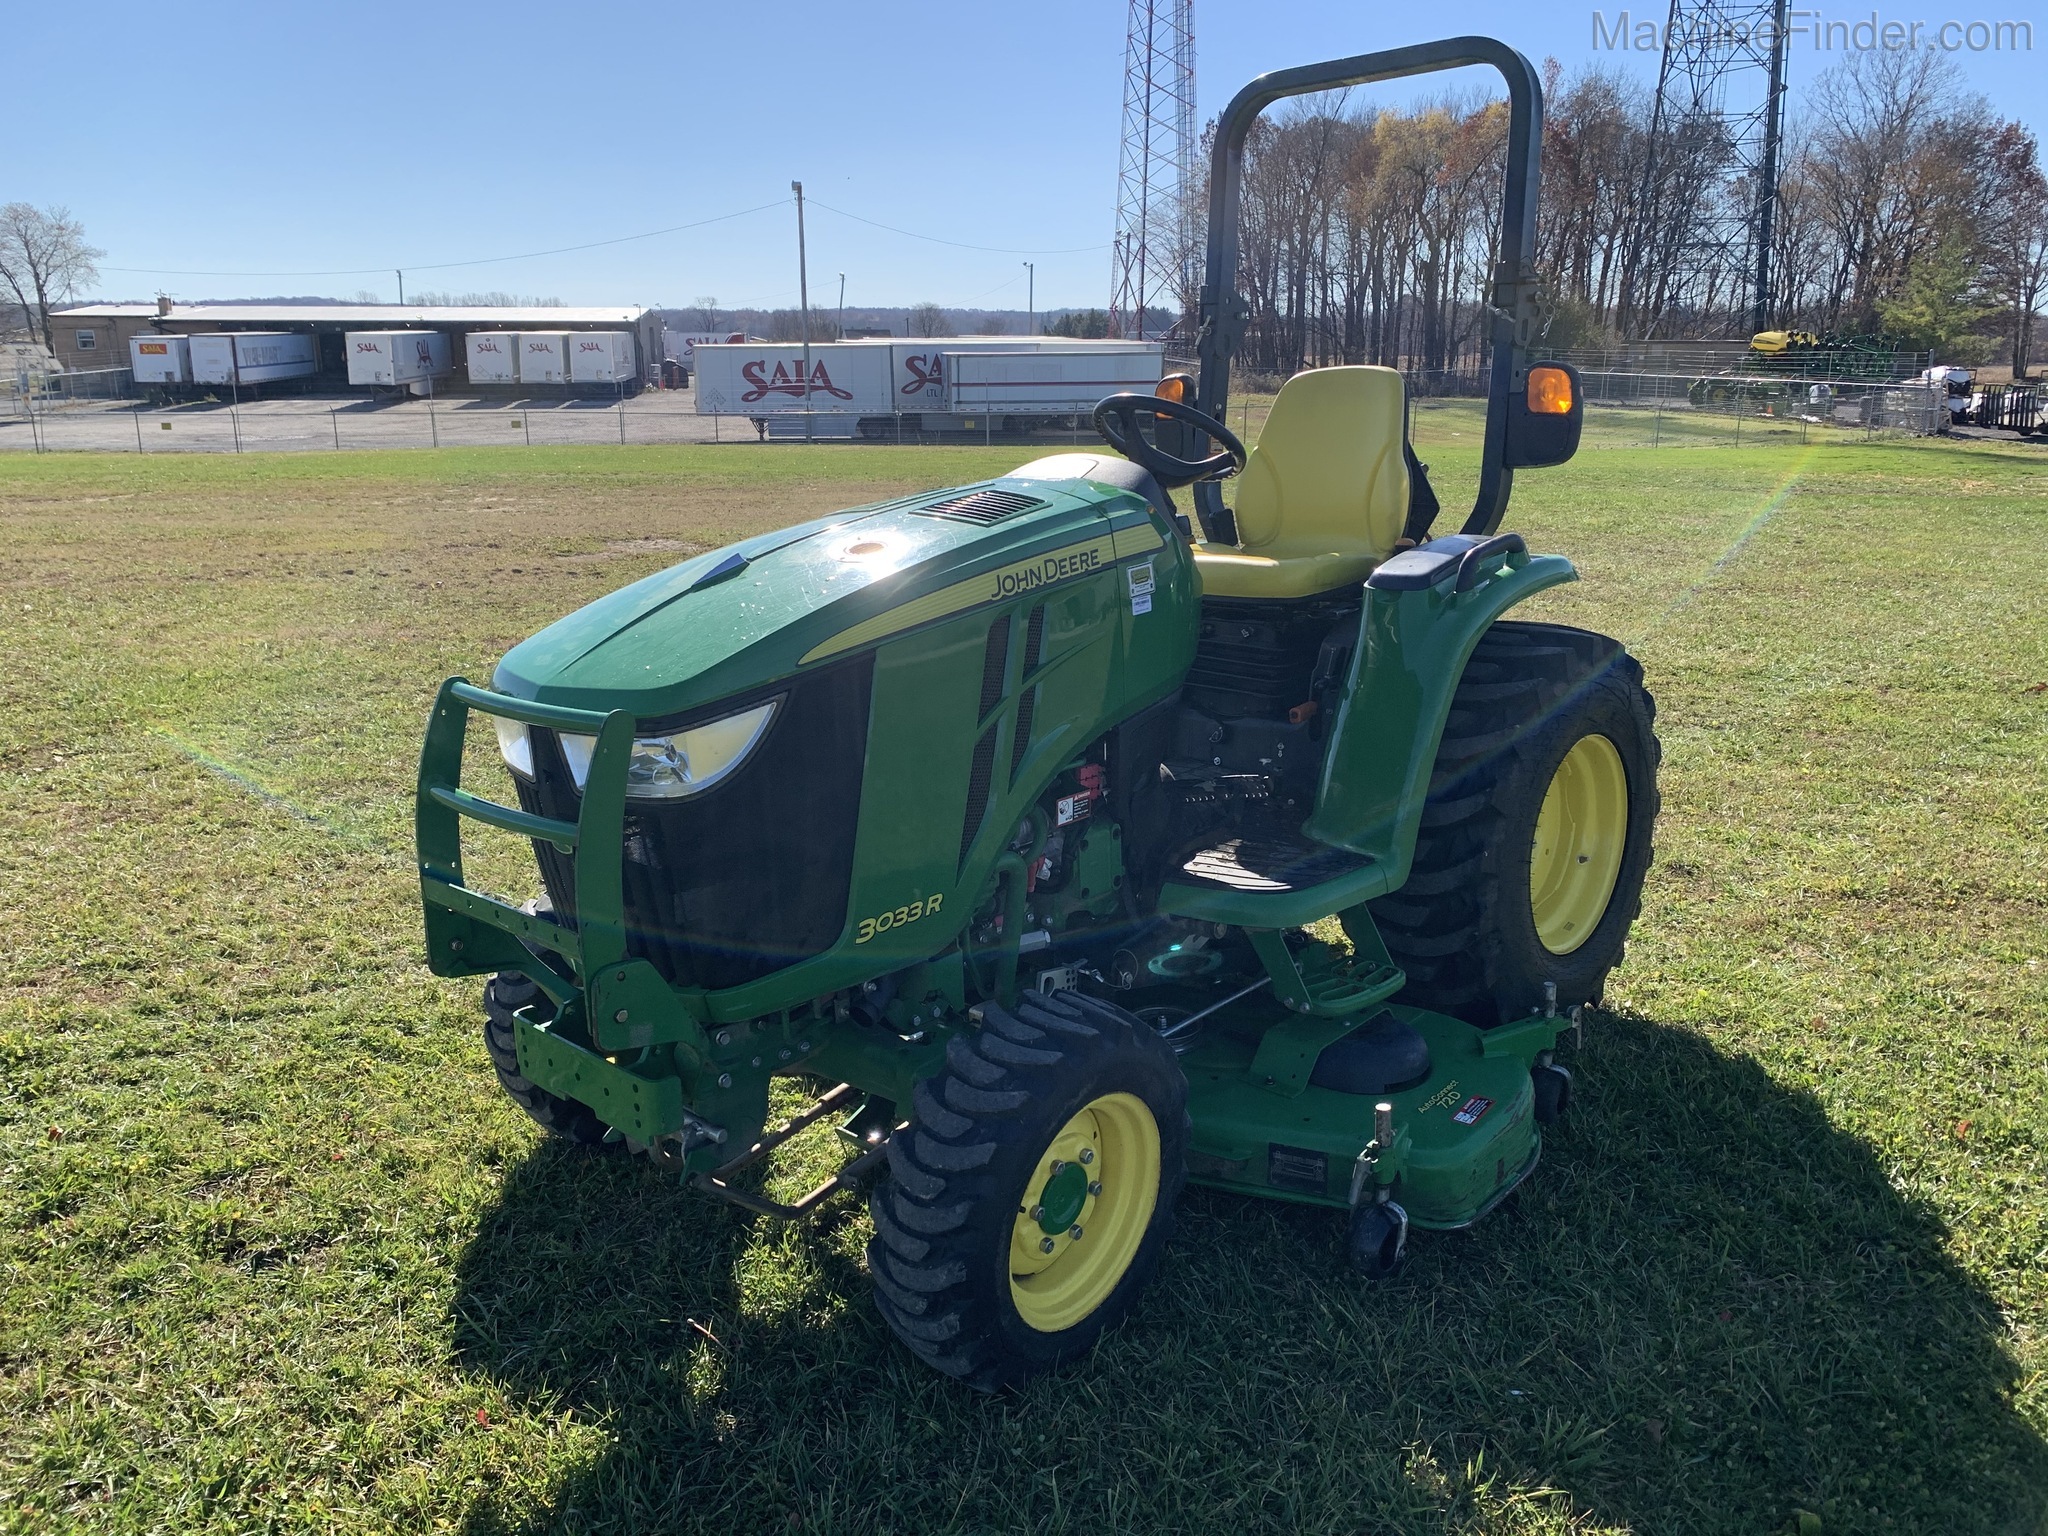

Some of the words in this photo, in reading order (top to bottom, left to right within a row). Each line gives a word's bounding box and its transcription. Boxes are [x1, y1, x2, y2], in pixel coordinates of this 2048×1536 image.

[142, 344, 165, 354] SAIA
[356, 342, 382, 354] SAIA
[477, 343, 502, 354] SAIA
[528, 343, 553, 354] SAIA
[579, 342, 604, 353] SAIA
[741, 359, 853, 403] SAIA
[900, 353, 943, 395] SA
[991, 565, 1042, 598] JOHN
[1044, 548, 1101, 578] DEERE
[1418, 1080, 1460, 1114] AutoConnect
[1436, 1091, 1461, 1109] 72D
